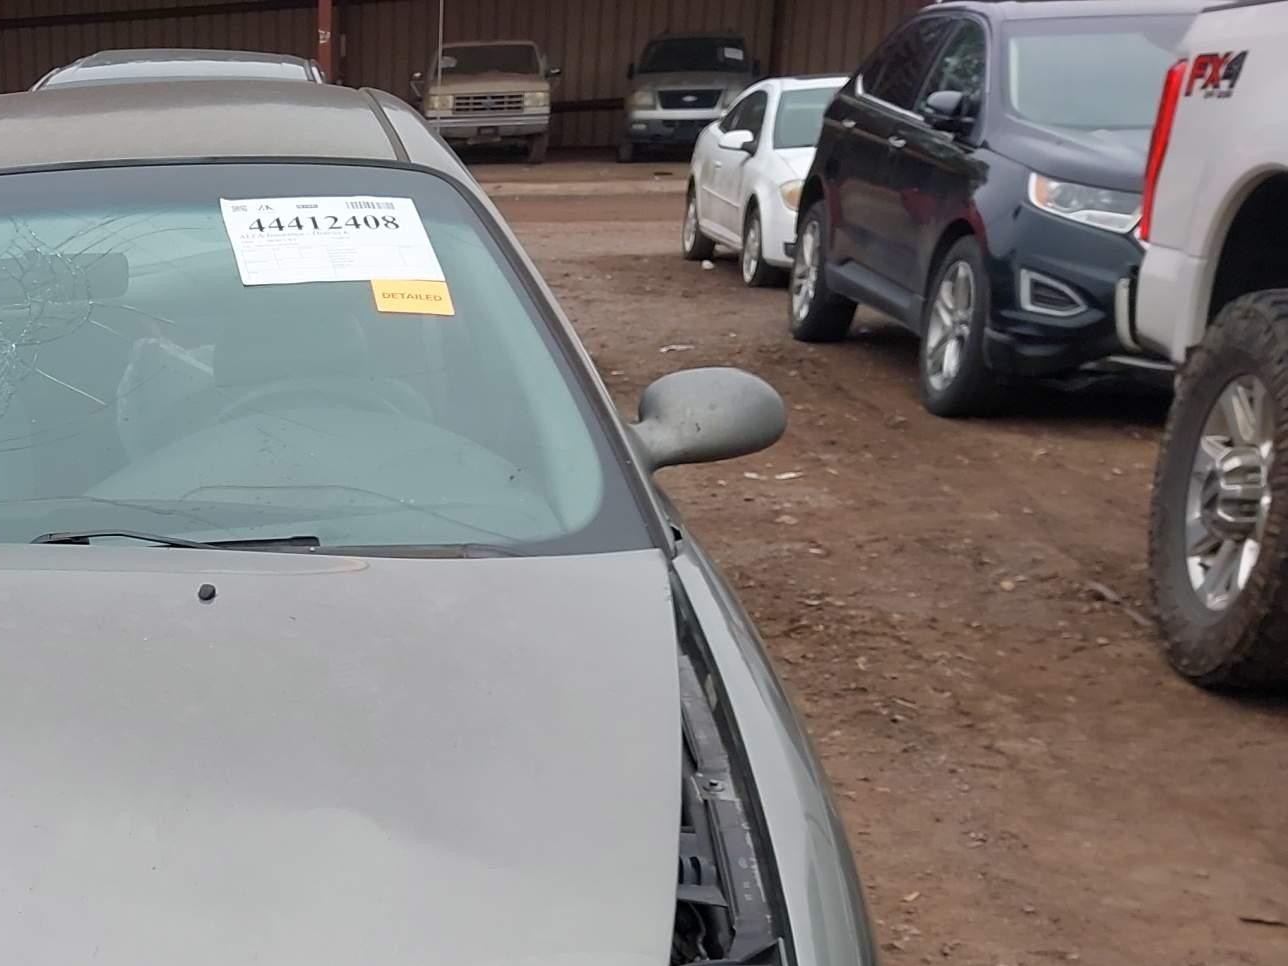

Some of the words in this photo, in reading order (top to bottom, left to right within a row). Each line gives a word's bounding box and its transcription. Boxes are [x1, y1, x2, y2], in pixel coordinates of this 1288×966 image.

[1185, 50, 1248, 96] FX4
[249, 215, 400, 232] 44412408
[382, 292, 443, 302] DETAILED
